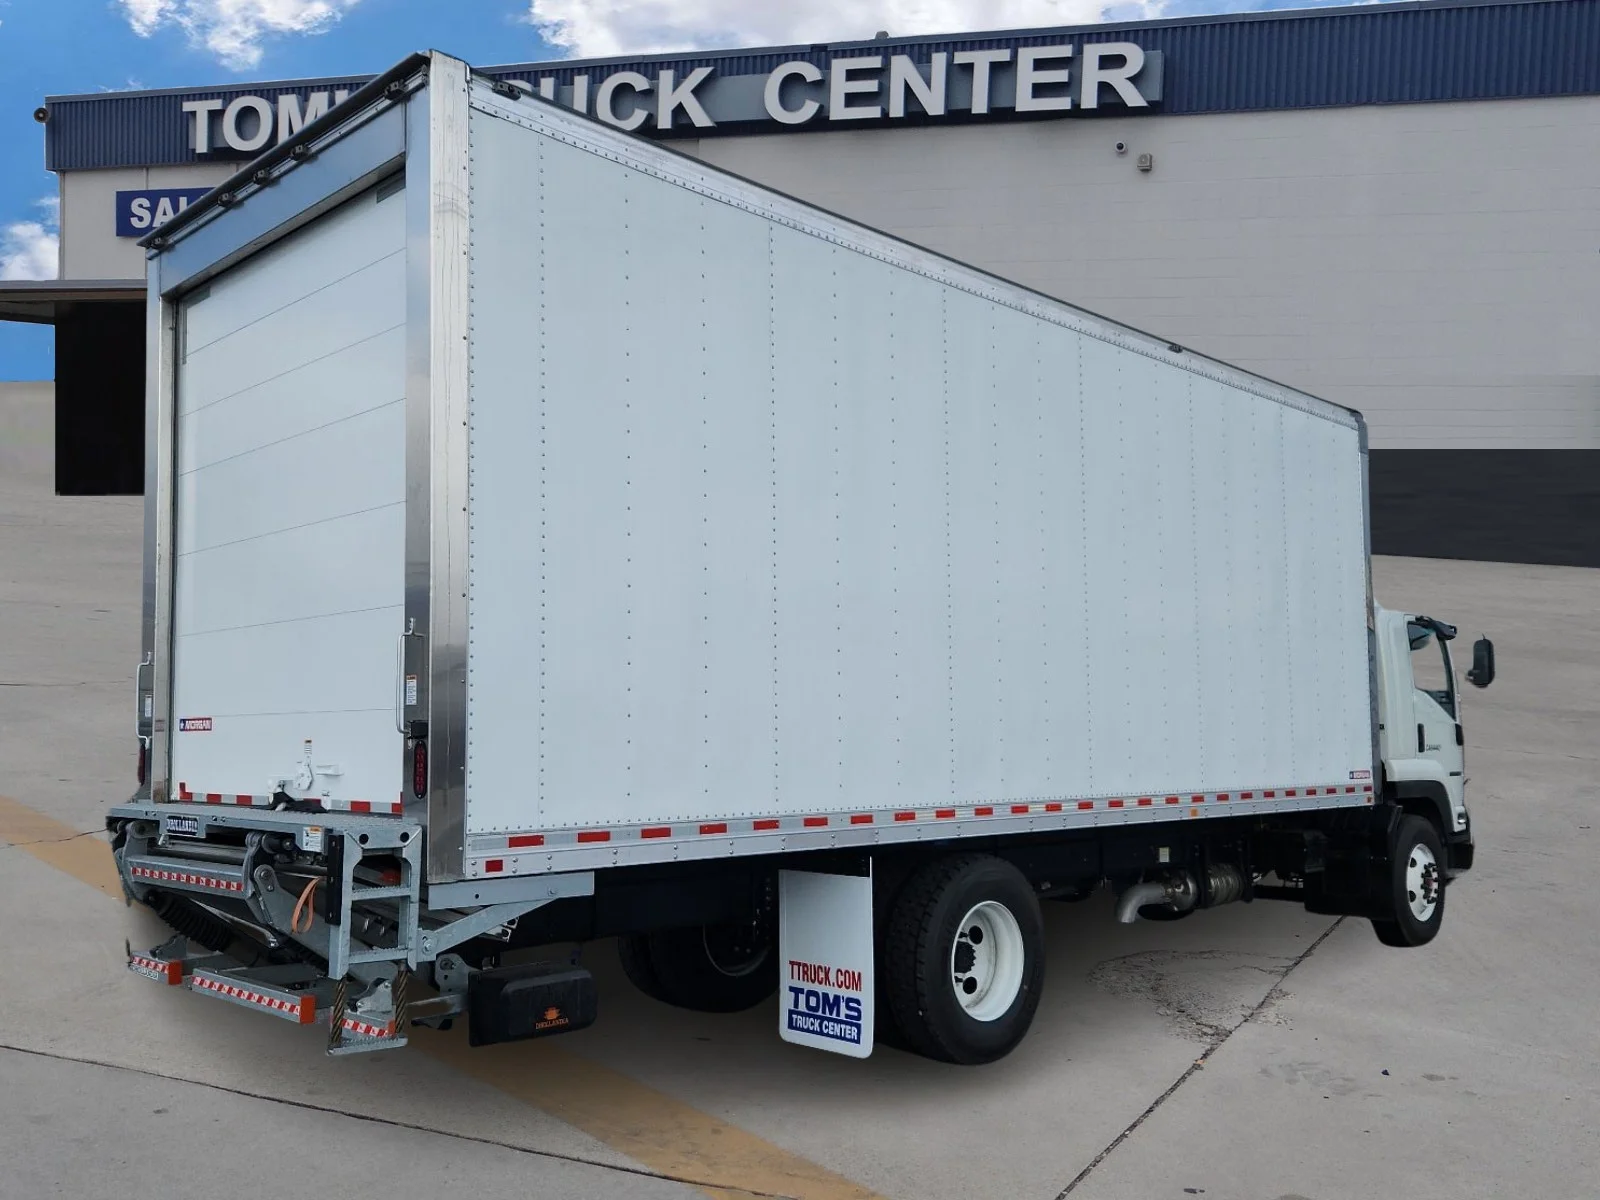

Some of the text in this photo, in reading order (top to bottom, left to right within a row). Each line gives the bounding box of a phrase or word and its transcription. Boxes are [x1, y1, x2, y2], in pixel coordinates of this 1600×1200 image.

[763, 42, 1149, 126] CENTER
[788, 960, 862, 992] TTRUCK.COM
[788, 986, 862, 1022] TOM'S
[792, 1014, 858, 1041] TRUCK CENTER
